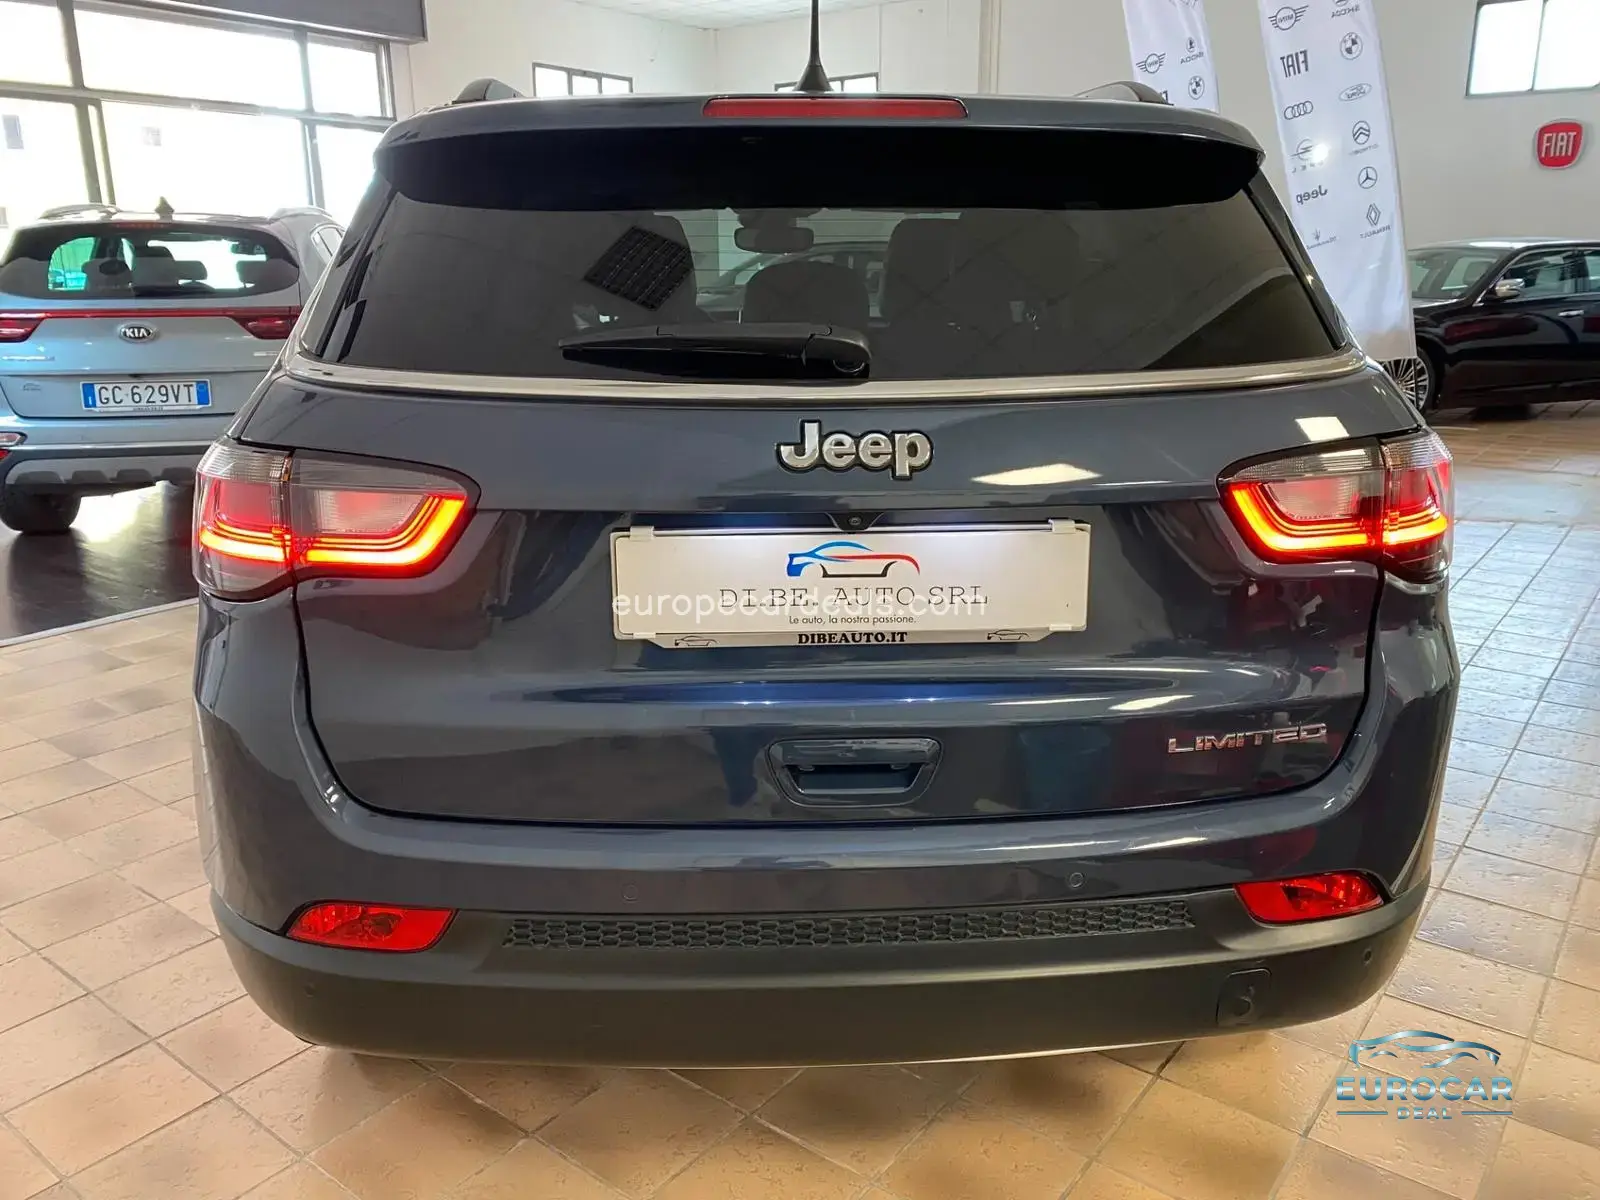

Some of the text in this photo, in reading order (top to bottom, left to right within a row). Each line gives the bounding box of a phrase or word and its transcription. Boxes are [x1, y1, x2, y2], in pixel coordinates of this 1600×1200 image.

[1541, 132, 1577, 158] FIAT
[125, 327, 148, 338] KIA
[777, 420, 933, 480] Jeep
[833, 586, 916, 606] AUTO
[928, 585, 988, 605] SRL
[788, 614, 917, 626] Le auto, la nostra passione.
[798, 631, 908, 645] DIBEAUTO.IT
[1167, 722, 1328, 754] LIMITED
